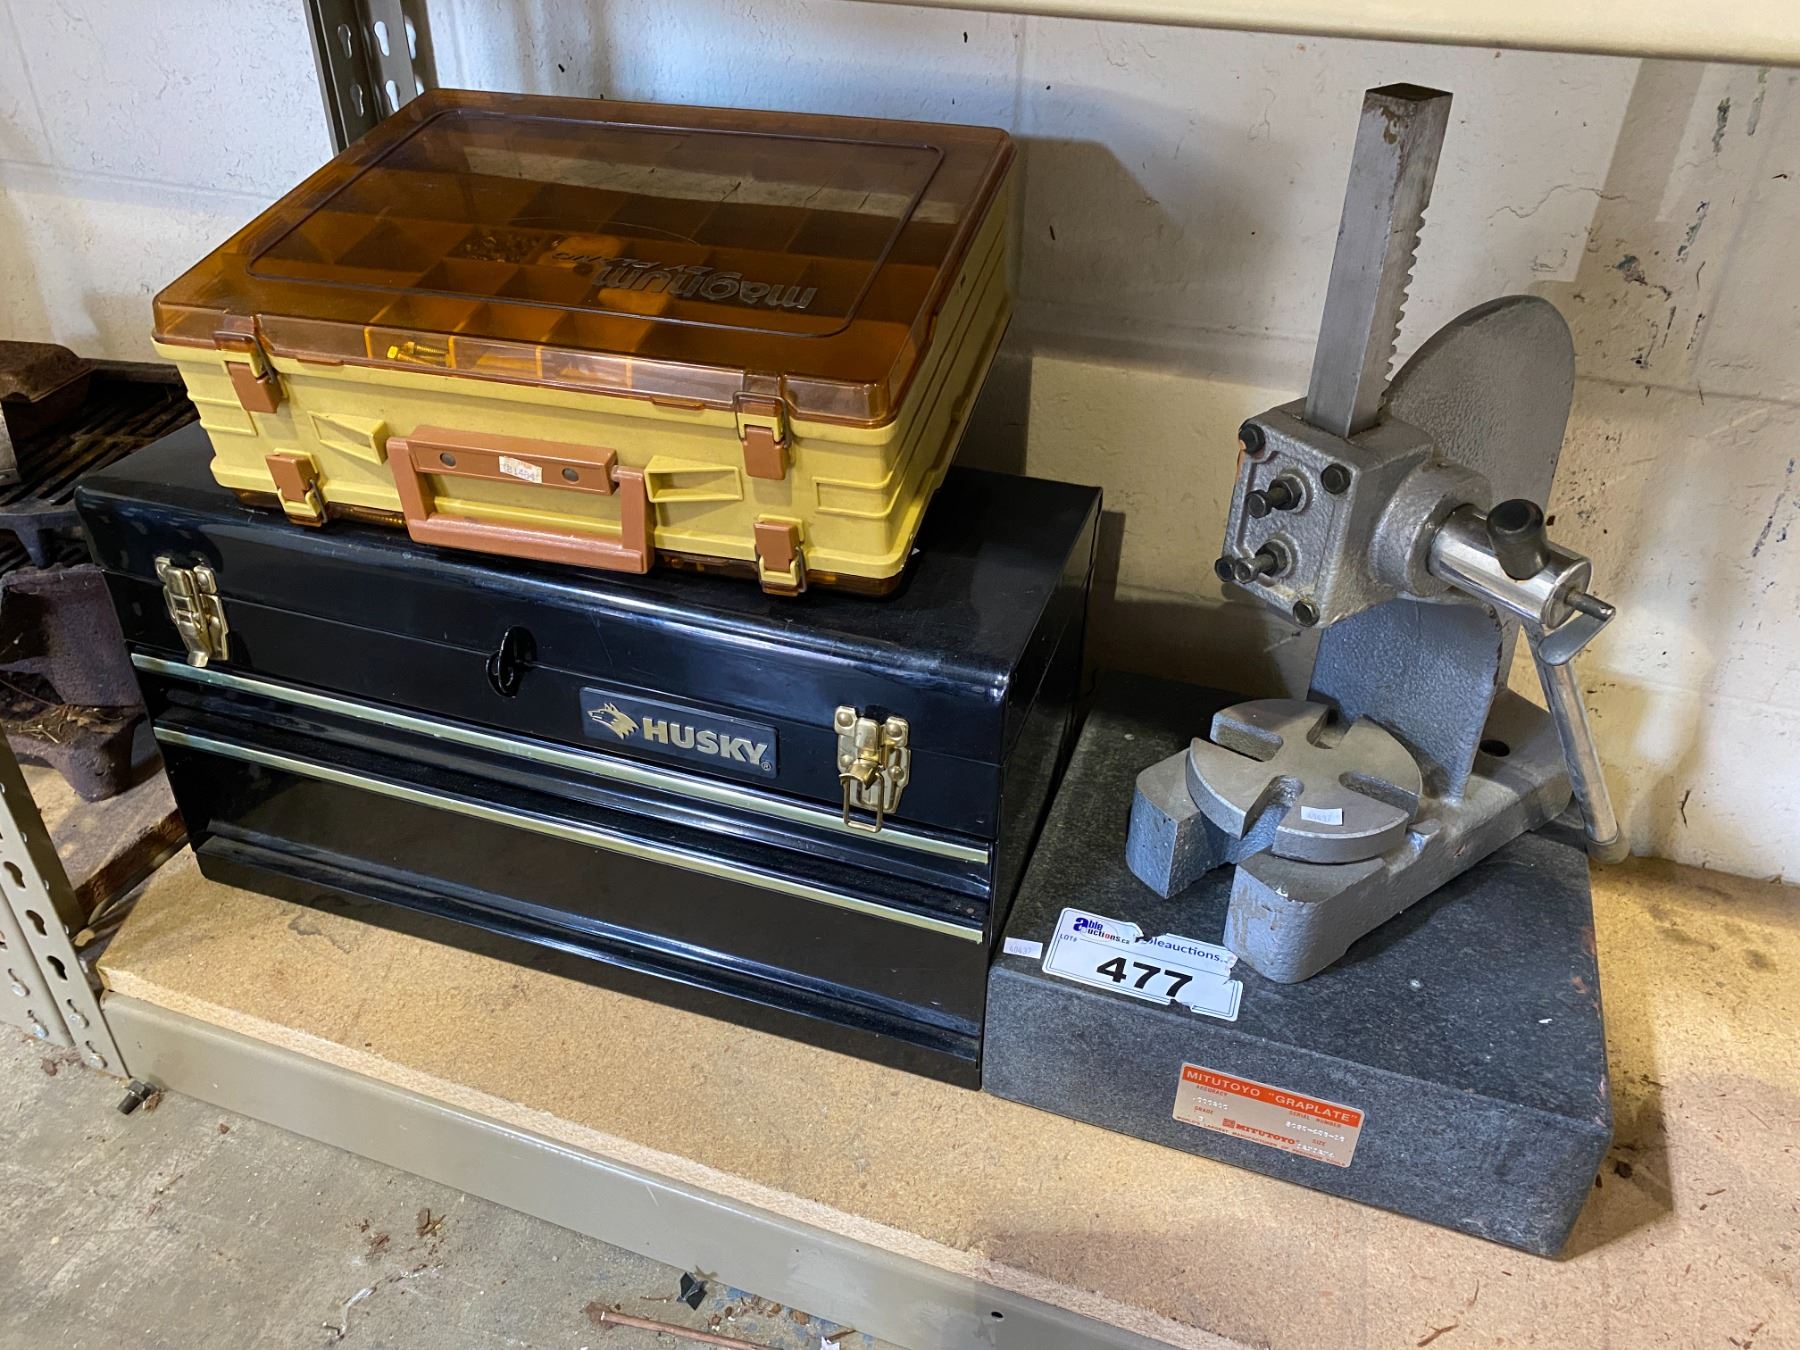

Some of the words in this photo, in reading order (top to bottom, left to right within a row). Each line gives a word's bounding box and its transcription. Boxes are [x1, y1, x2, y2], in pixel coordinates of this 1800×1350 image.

[593, 265, 818, 309] magnum
[642, 717, 768, 766] HUSKY
[1096, 956, 1193, 998] 477
[1186, 1070, 1261, 1097] MITUTOYO
[1235, 1123, 1296, 1145] MITUTOYO
